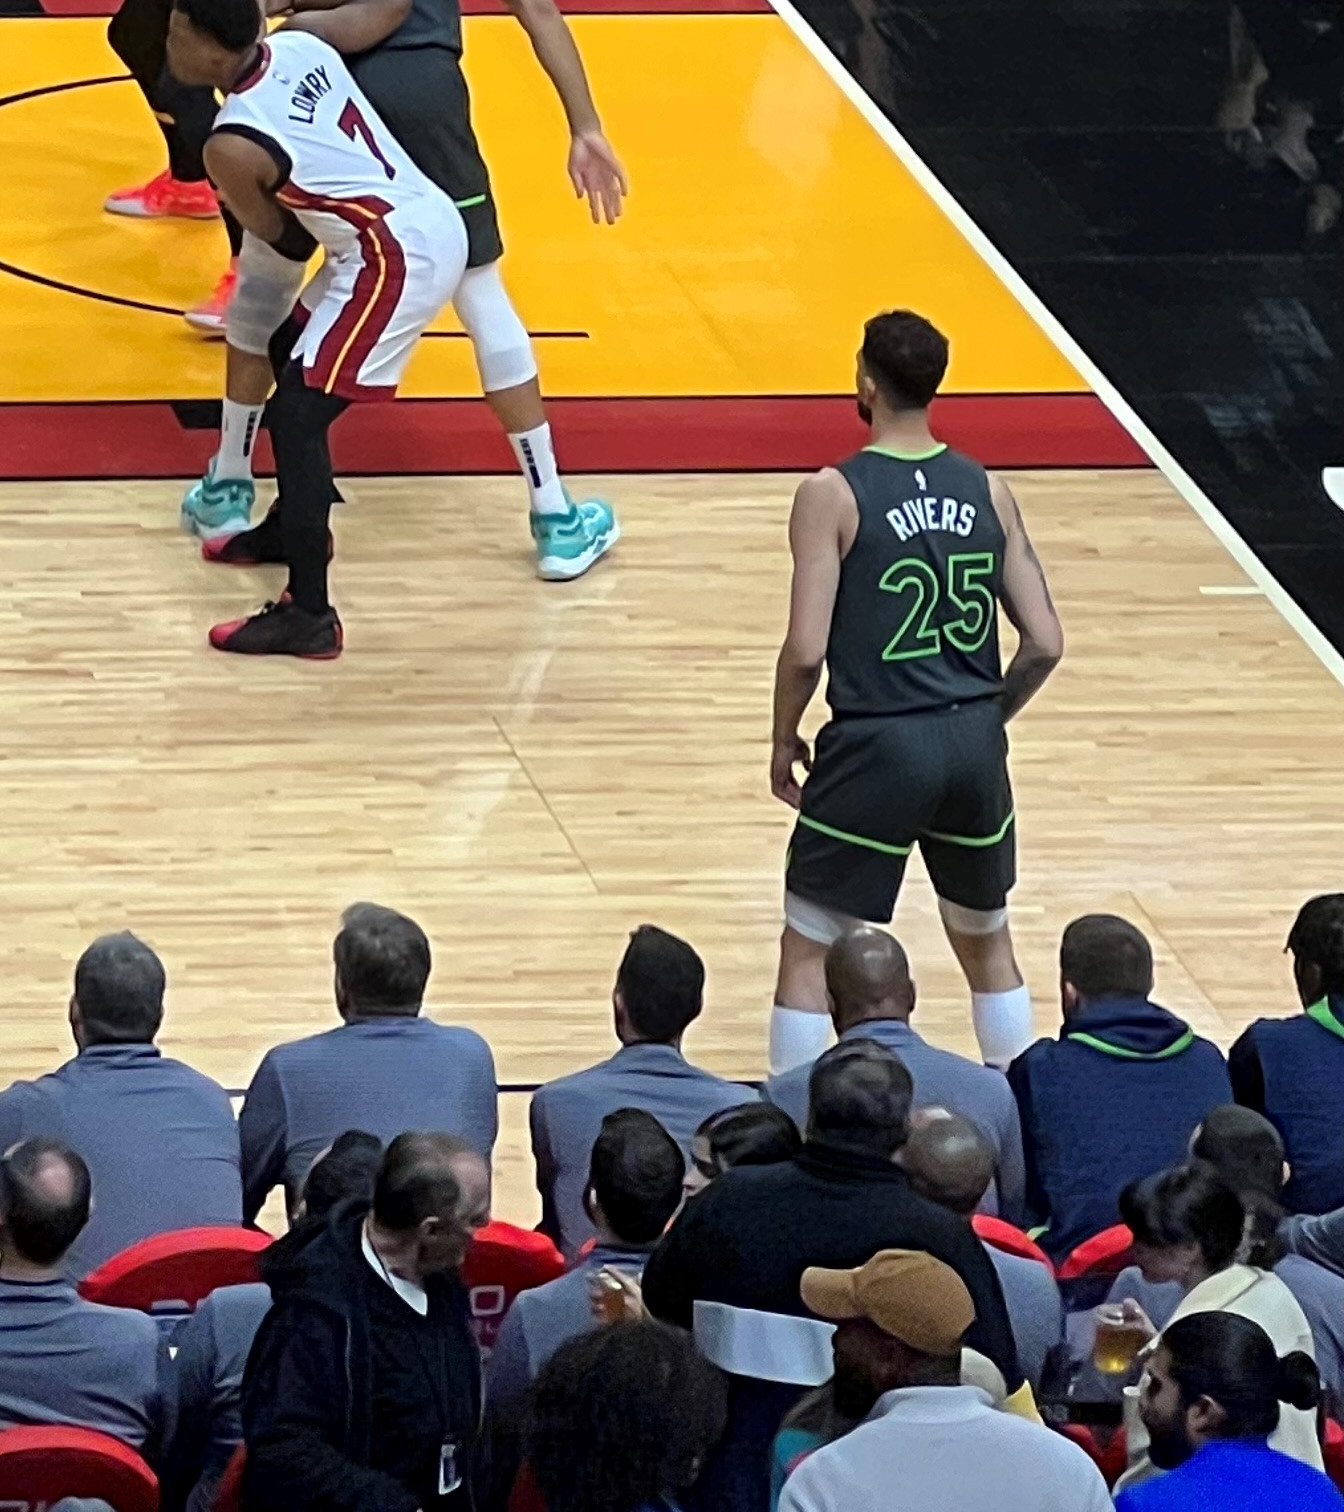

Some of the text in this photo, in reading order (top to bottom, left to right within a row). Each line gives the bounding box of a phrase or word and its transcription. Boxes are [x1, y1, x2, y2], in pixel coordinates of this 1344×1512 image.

[288, 64, 332, 124] LOWRY
[337, 96, 396, 181] 7
[886, 497, 978, 542] RIVERS
[879, 552, 997, 661] 25
